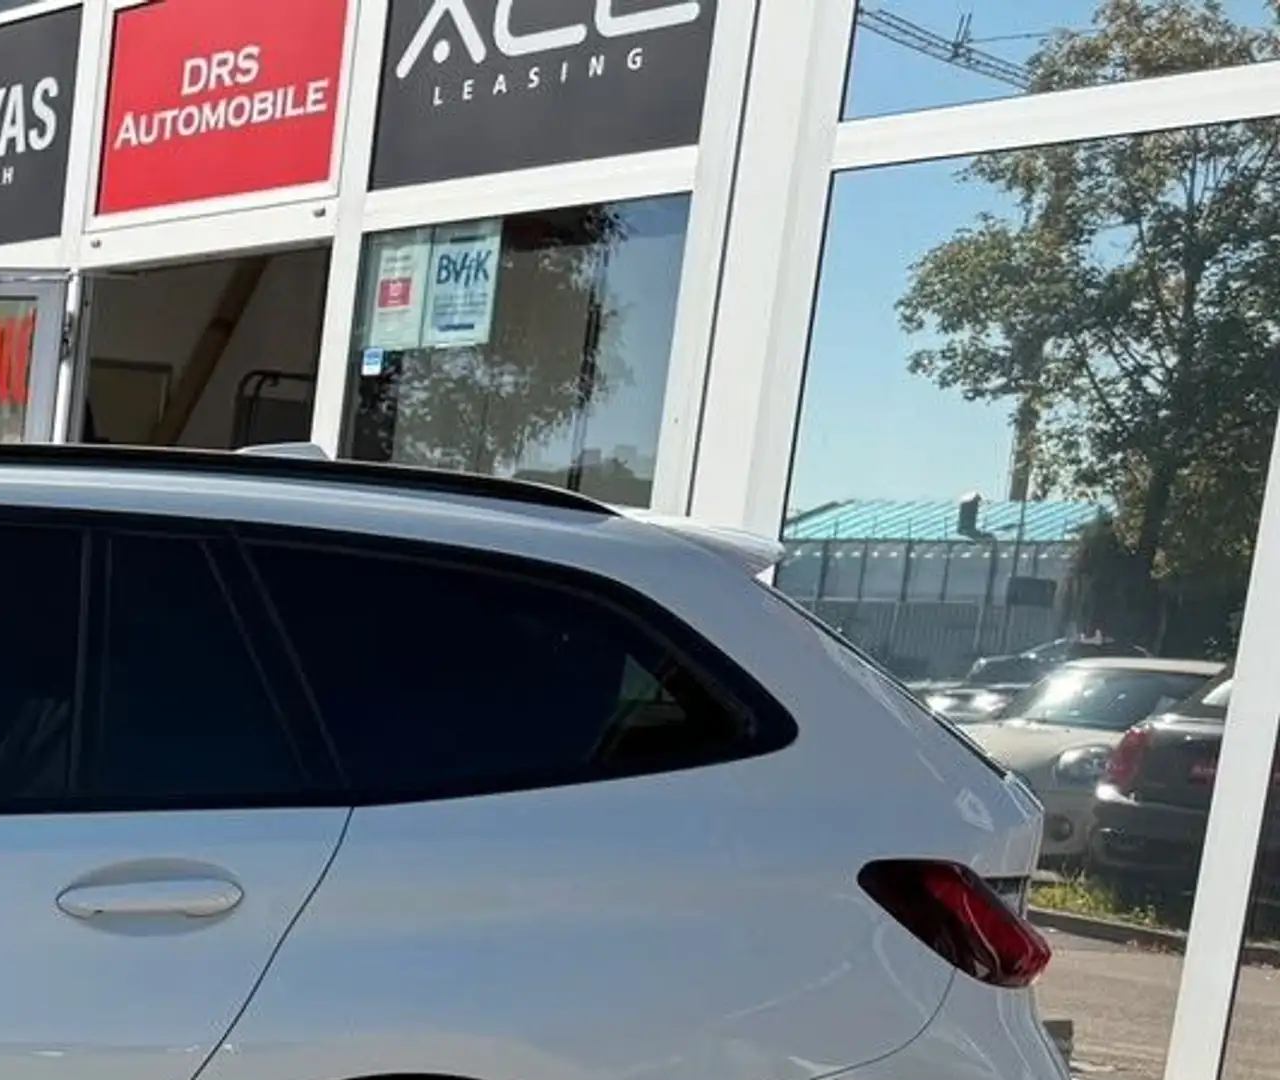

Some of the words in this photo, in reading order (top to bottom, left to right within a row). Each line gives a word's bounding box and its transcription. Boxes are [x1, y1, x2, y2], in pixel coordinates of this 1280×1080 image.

[180, 45, 260, 96] DRS
[432, 48, 643, 106] LEASING
[113, 78, 329, 149] AUTOMOBILE
